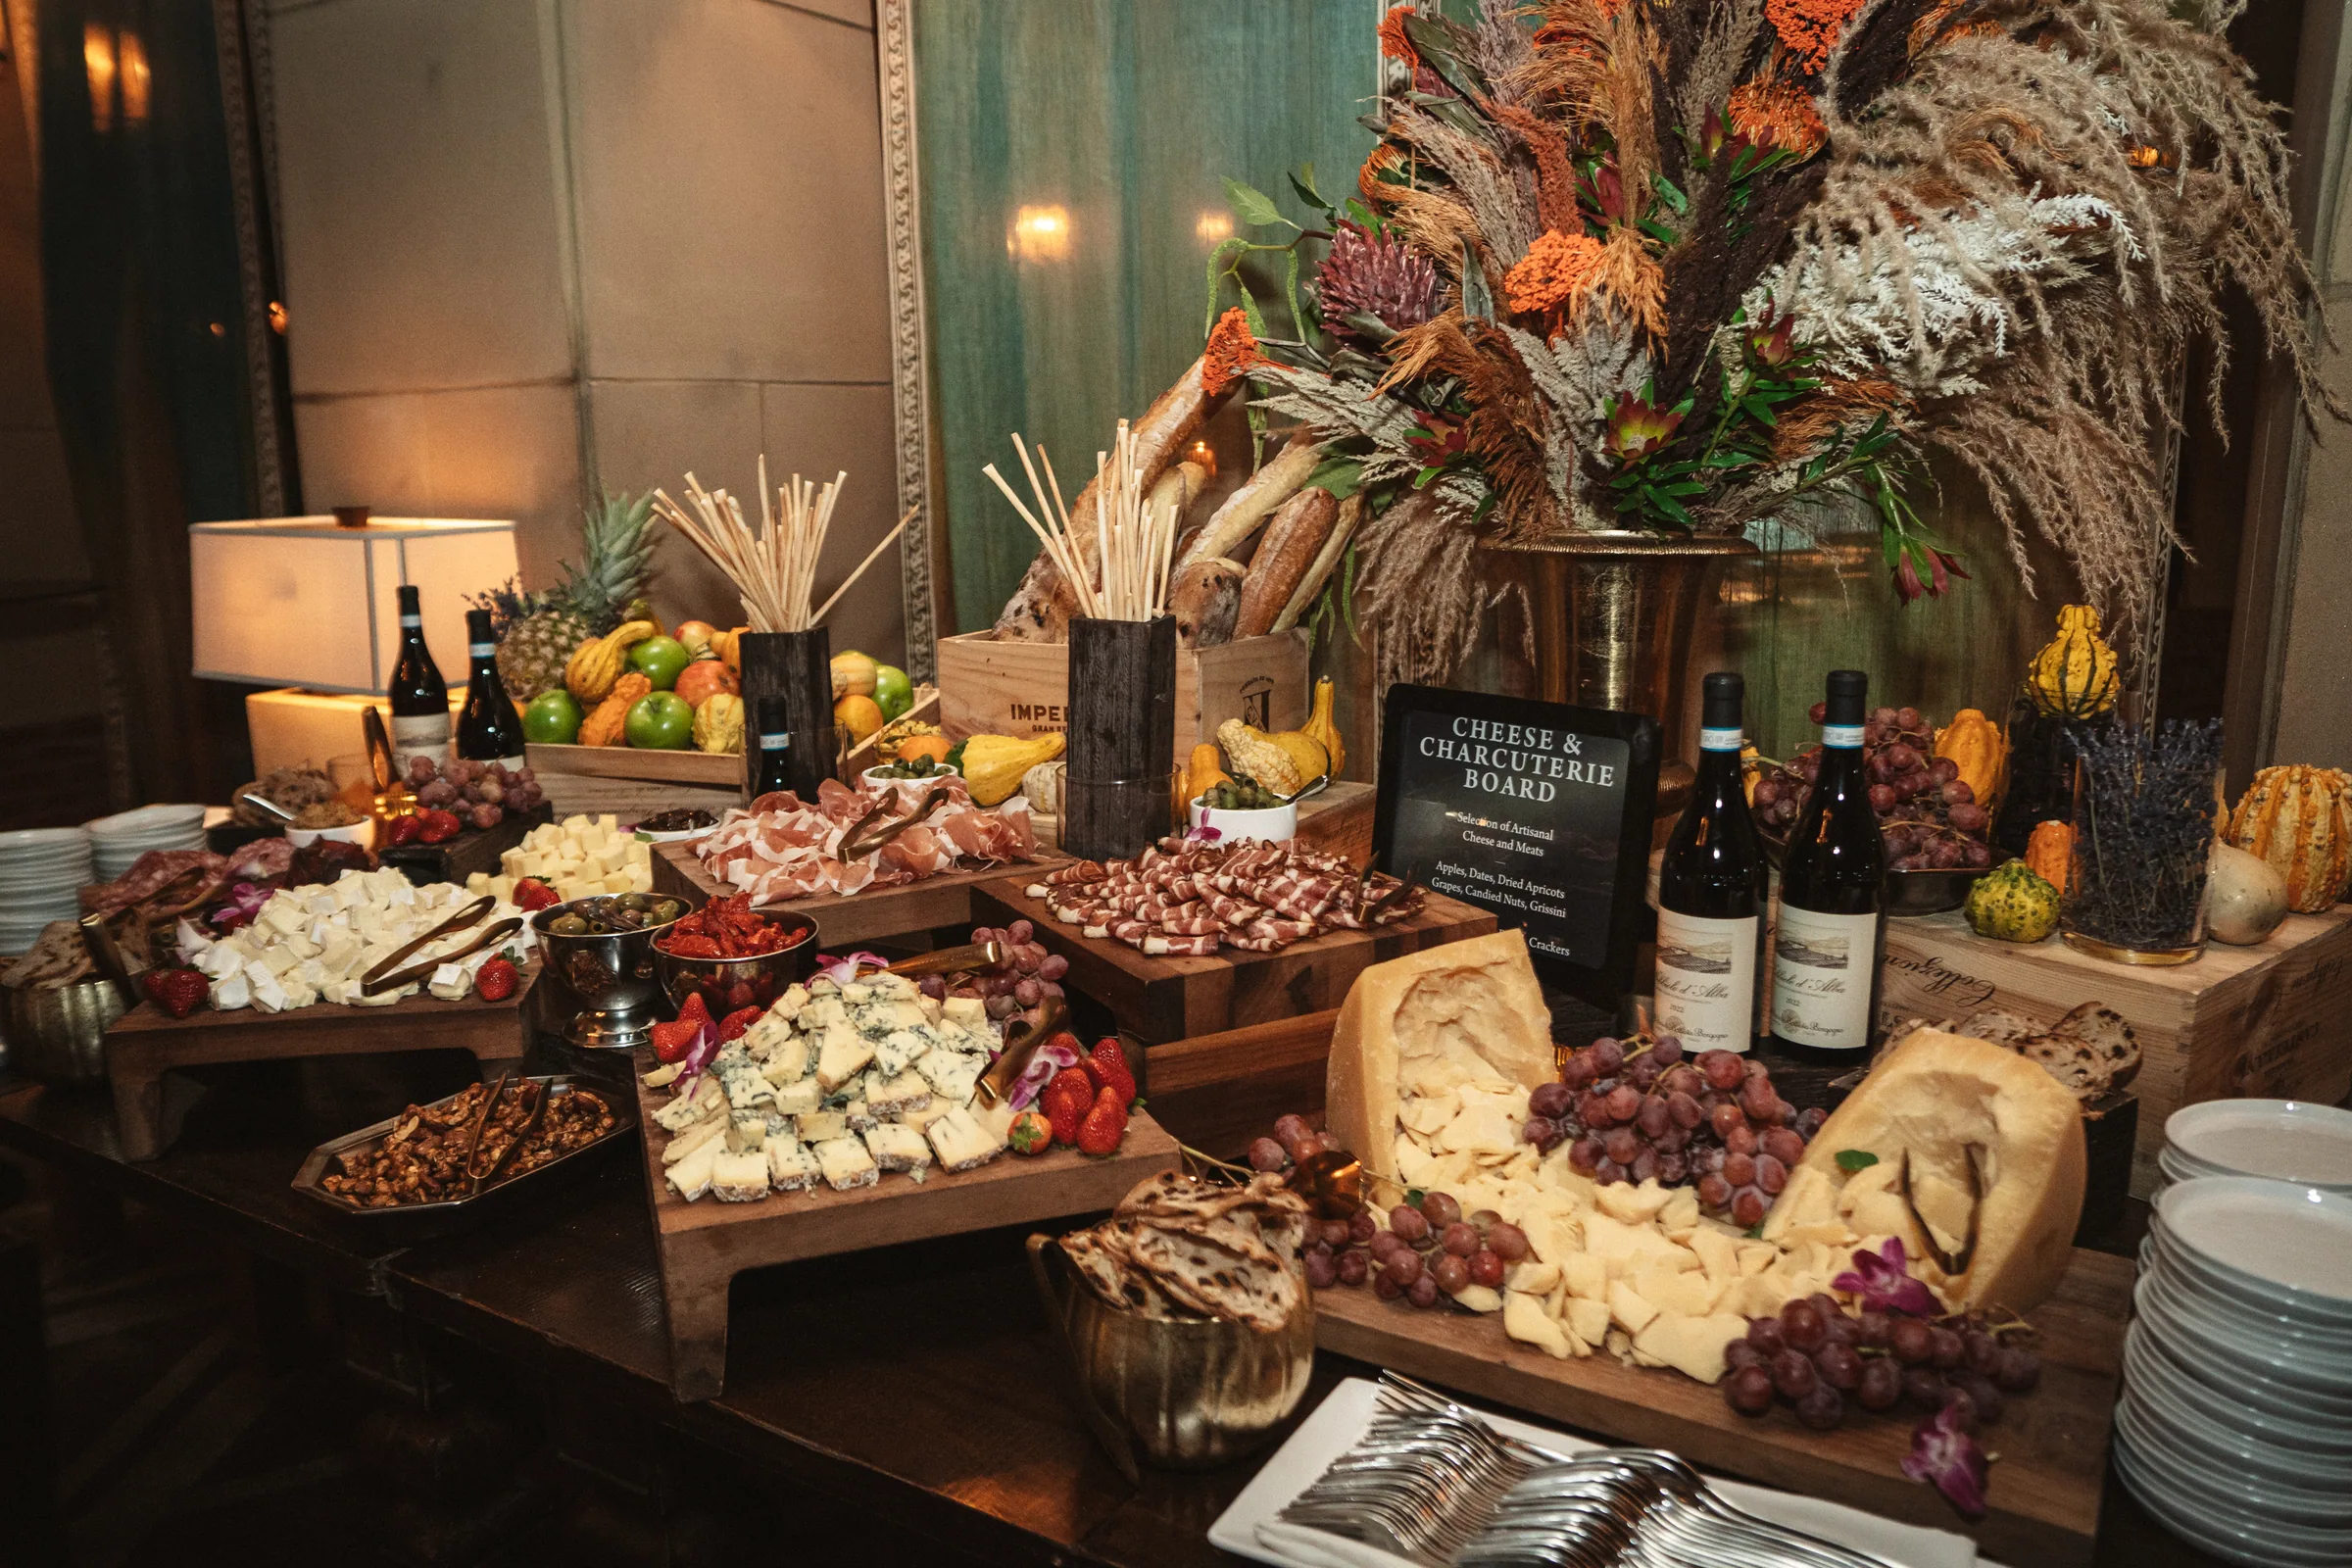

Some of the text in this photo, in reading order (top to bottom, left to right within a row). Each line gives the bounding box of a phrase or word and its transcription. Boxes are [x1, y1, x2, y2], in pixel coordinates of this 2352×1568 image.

[1032, 724, 1054, 733] GRAN
[1452, 716, 1583, 756] CHEESE &
[1419, 736, 1614, 788] CHARCUTERIE
[1463, 768, 1556, 803] BOARD
[1457, 811, 1554, 841] Selection of Artisanal
[1462, 831, 1544, 858] Cheese and Meats
[1436, 860, 1565, 900] Apples, Dates, Dried Apricots
[1432, 877, 1567, 918] Grapes, Candied Nuts, Grissini
[1529, 937, 1570, 956] Crackers
[1669, 1004, 1685, 1013] 2022
[1786, 998, 1800, 1006] 2022
